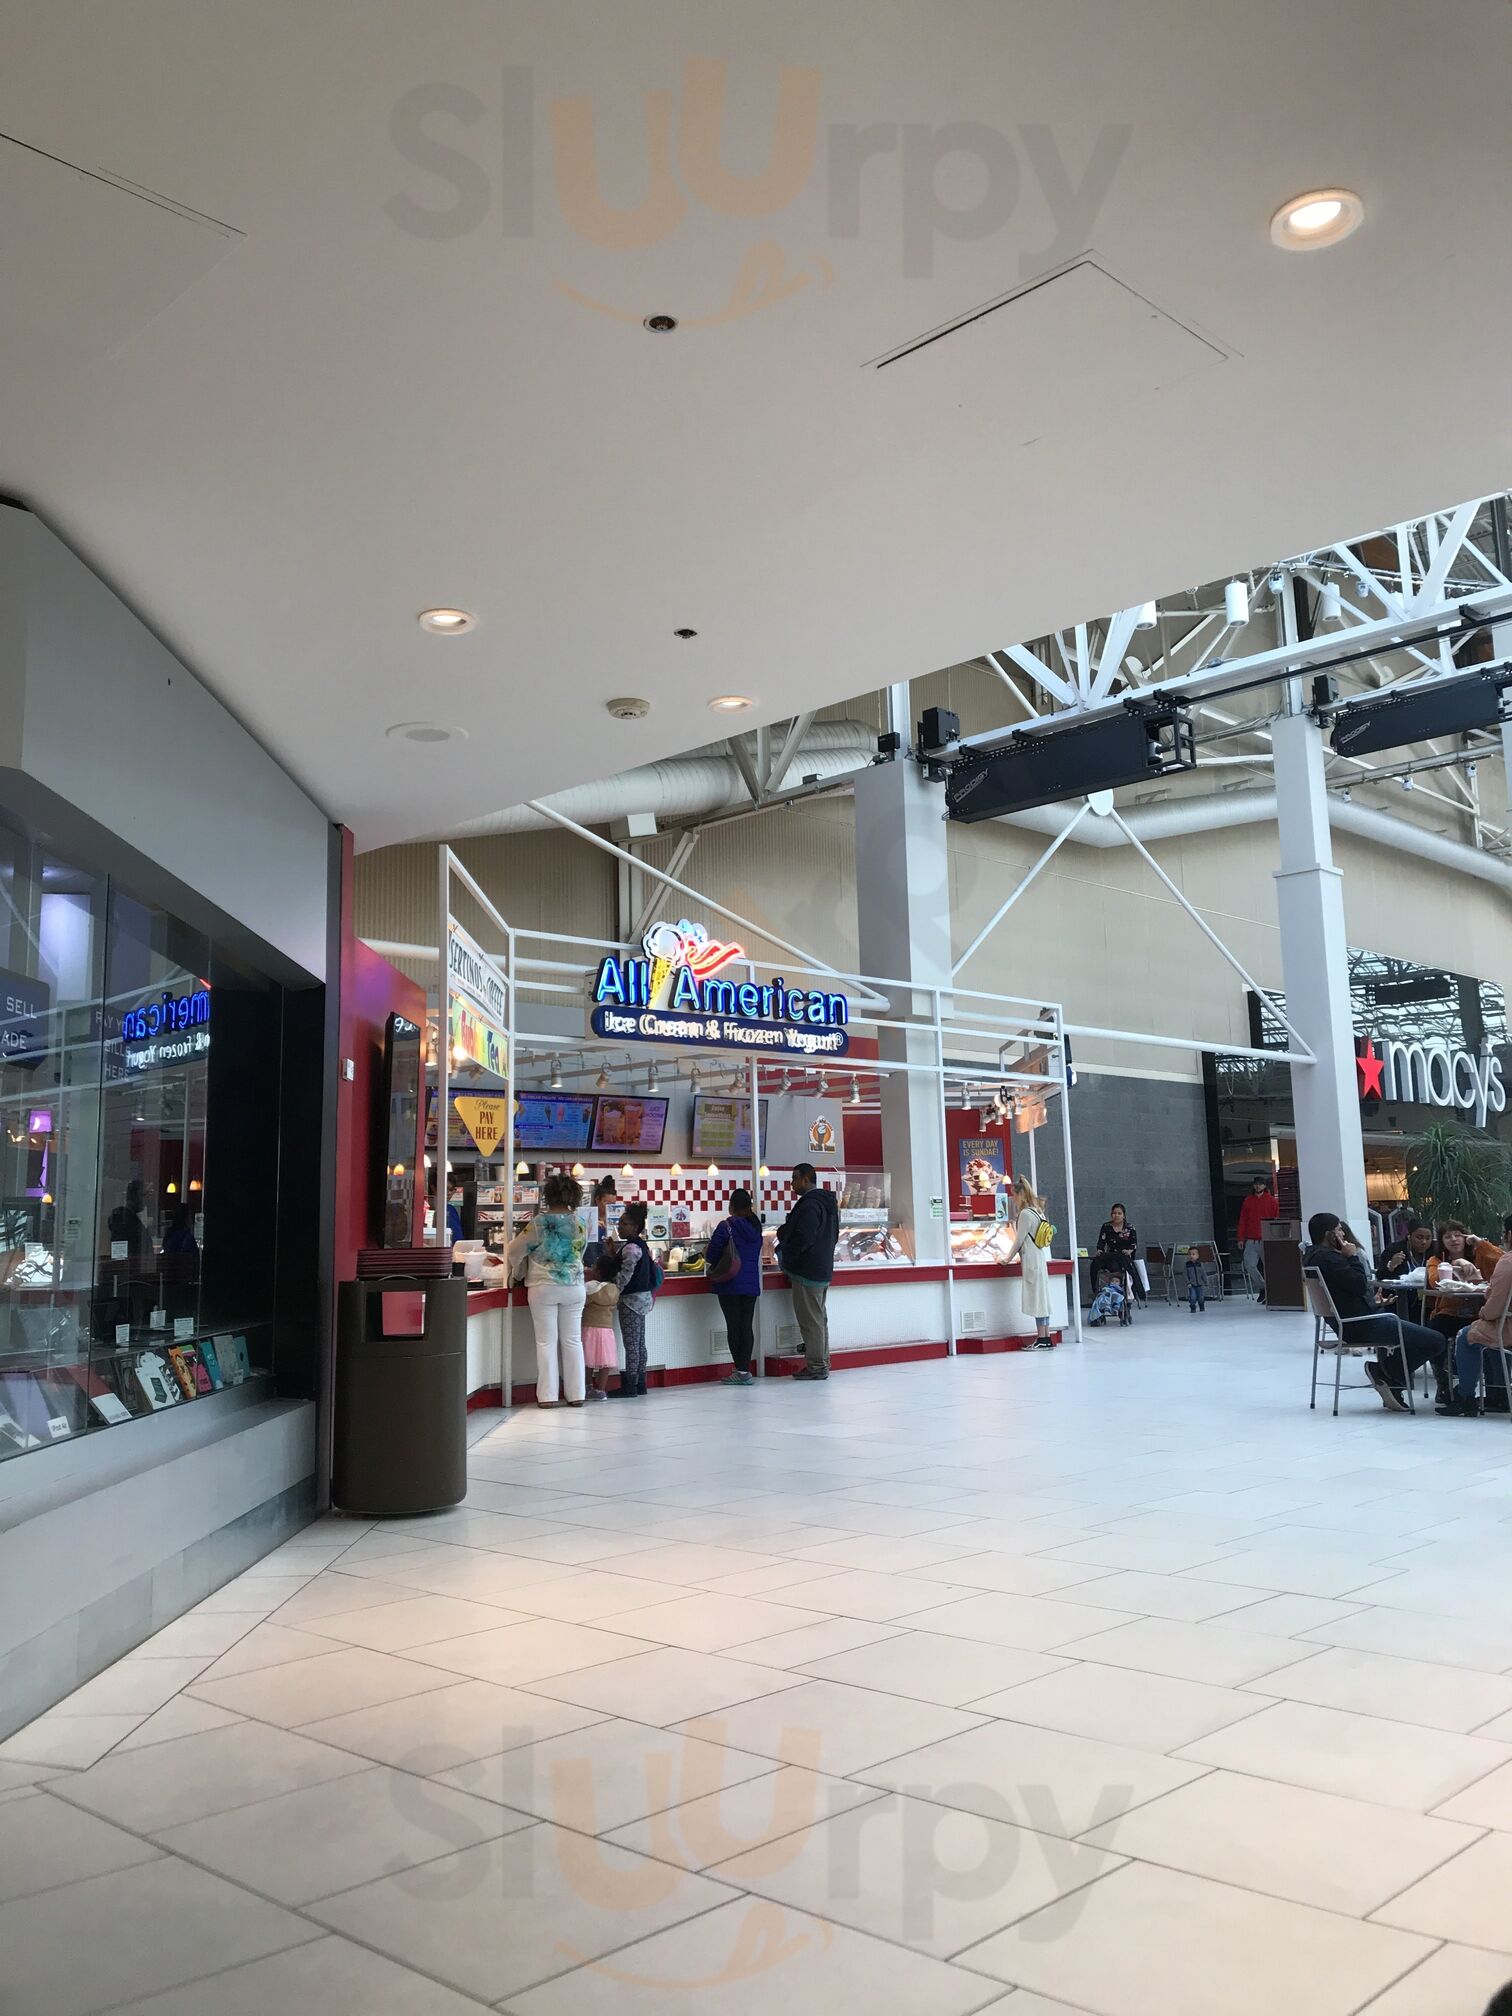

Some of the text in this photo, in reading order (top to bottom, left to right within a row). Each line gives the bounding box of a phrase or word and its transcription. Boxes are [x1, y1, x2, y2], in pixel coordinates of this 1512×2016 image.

[953, 767, 989, 802] PRODIGY
[592, 957, 848, 1025] All American
[6, 996, 37, 1019] SELL
[604, 1011, 636, 1033] Ice
[639, 1014, 703, 1038] Cream
[705, 1020, 721, 1039] &
[724, 1022, 783, 1044] Frozen
[105, 1063, 129, 1081] HERE
[474, 1100, 501, 1111] Please
[480, 1111, 494, 1124] PAY
[475, 1127, 498, 1140] HERE
[962, 1140, 998, 1149] EVERY DAY
[963, 1148, 999, 1157] IS SUNDAE!
